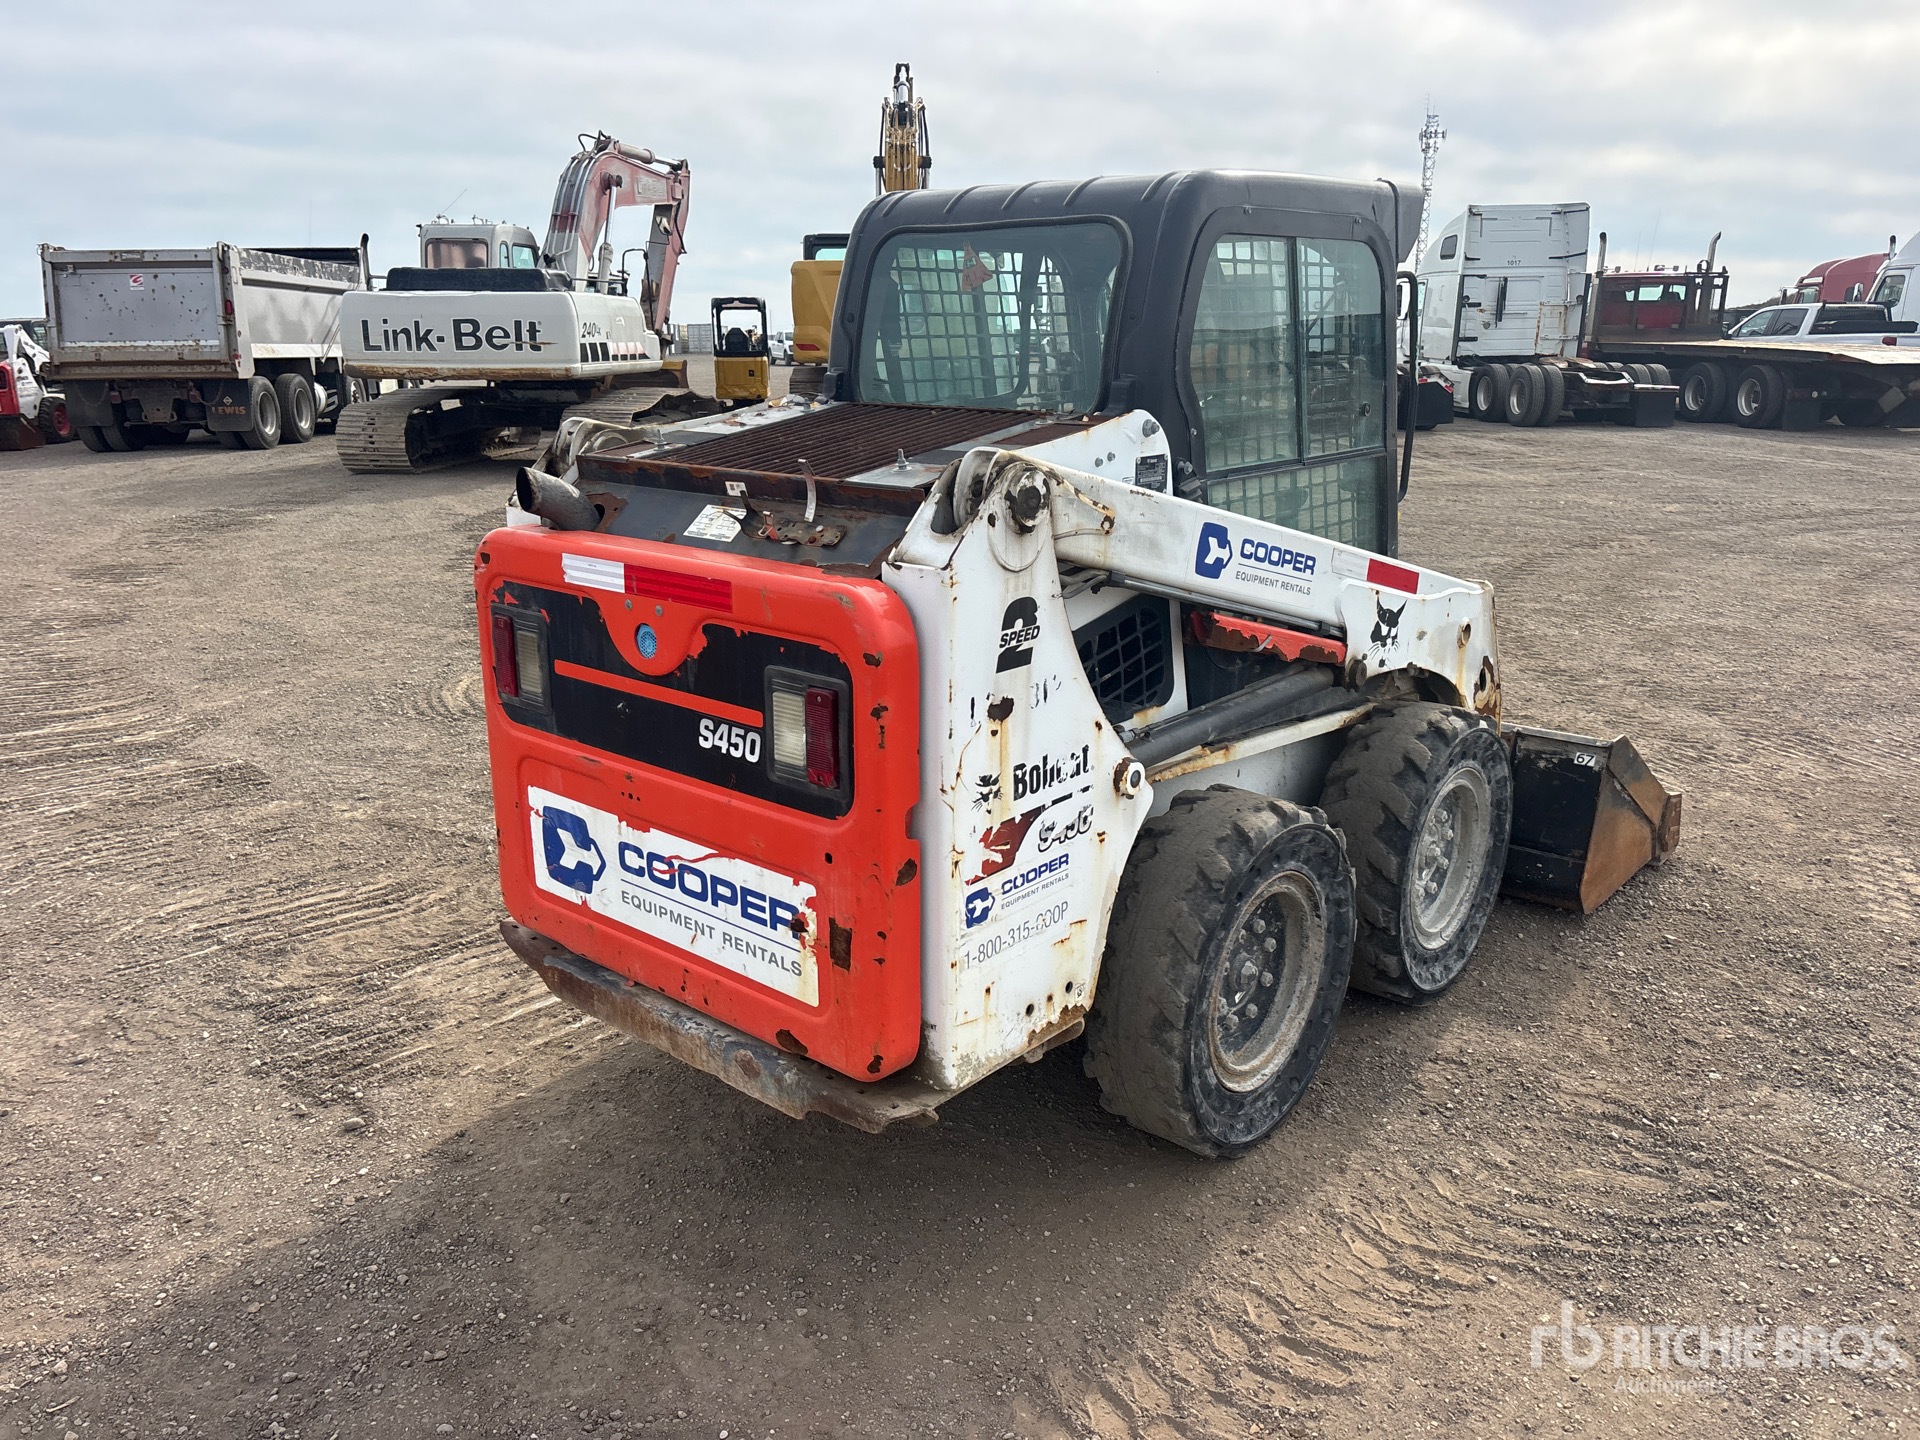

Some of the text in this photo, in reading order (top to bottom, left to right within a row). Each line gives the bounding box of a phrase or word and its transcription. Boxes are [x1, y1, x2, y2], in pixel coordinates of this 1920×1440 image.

[1239, 538, 1317, 576] COOPER
[1235, 570, 1311, 596] EQUIPMENT RENTALS
[999, 625, 1040, 649] SPEED
[698, 717, 762, 764] S450
[1576, 753, 1595, 766] 67
[618, 841, 801, 940] COOPER
[1000, 853, 1070, 895] COOPER
[1000, 872, 1070, 911] EQUIPMENT RENTALS
[620, 889, 803, 977] EQUIPMENT RENTALS
